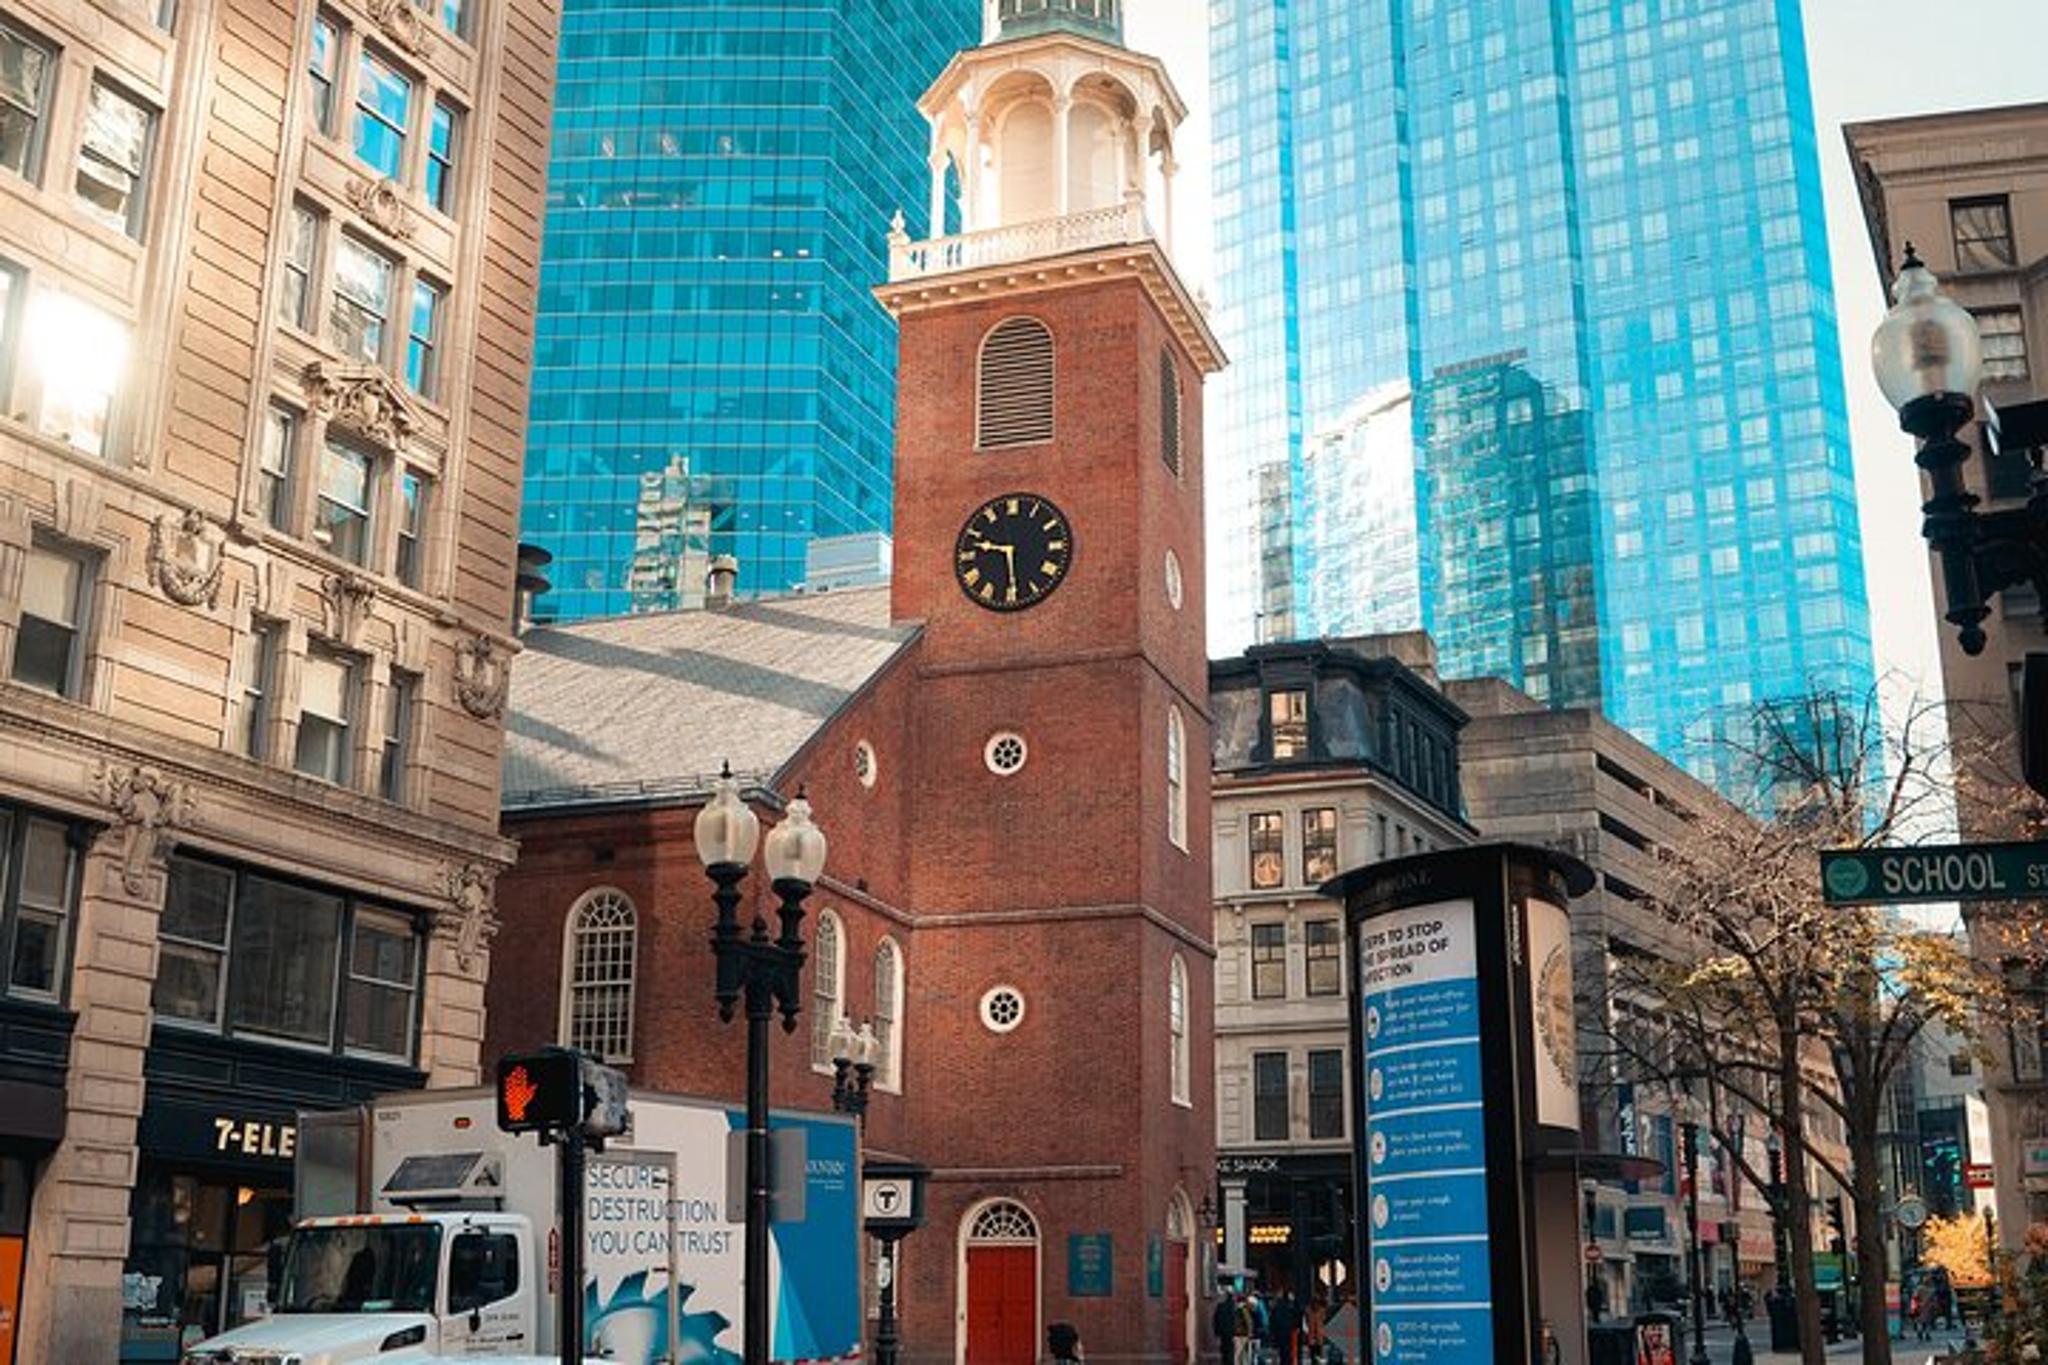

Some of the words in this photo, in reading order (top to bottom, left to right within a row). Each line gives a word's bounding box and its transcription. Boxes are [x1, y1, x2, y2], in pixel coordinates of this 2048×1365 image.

[1882, 853, 2006, 894] SCHOOL
[1388, 928, 1403, 942] TO
[1407, 921, 1443, 939] STOP
[1377, 941, 1426, 964] SPREAD
[1428, 937, 1449, 953] OF
[214, 1117, 296, 1158] 7-ELE
[587, 1163, 661, 1190] SECURE
[588, 1197, 718, 1223] DESTRUCTION
[879, 1190, 897, 1209] T
[588, 1230, 629, 1254] YOU
[633, 1230, 672, 1254] CAN
[677, 1231, 732, 1255] TRUST
